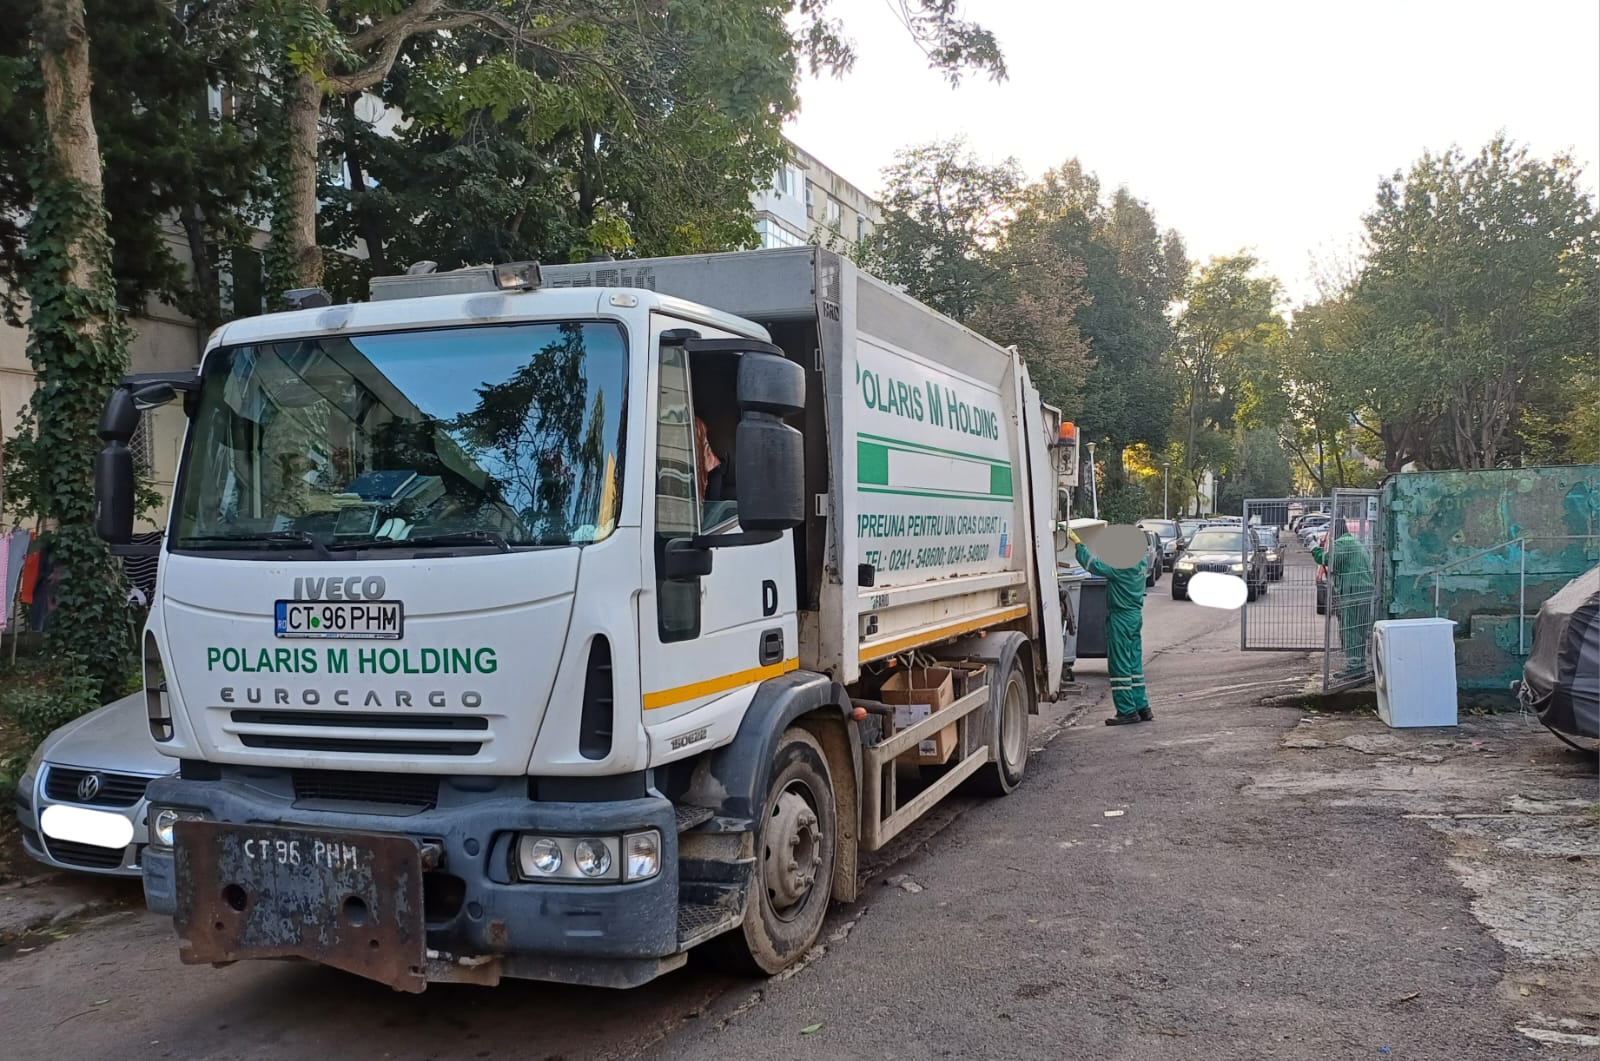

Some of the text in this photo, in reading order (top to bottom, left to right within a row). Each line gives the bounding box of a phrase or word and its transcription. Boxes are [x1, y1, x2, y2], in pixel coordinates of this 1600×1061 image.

[926, 381, 944, 427] M
[945, 387, 999, 440] HOLDING
[907, 515, 945, 537] PENTRU
[945, 516, 957, 536] UN
[957, 515, 977, 535] ORAS
[977, 516, 998, 534] CURAT
[293, 576, 386, 600] IVECO
[762, 580, 778, 616] D
[289, 606, 397, 631] CT 96 PHM
[207, 647, 498, 674] POLARIS M HOLDING
[220, 687, 482, 708] EUROCARGO
[244, 839, 268, 860] CT
[315, 840, 358, 870] PHM
